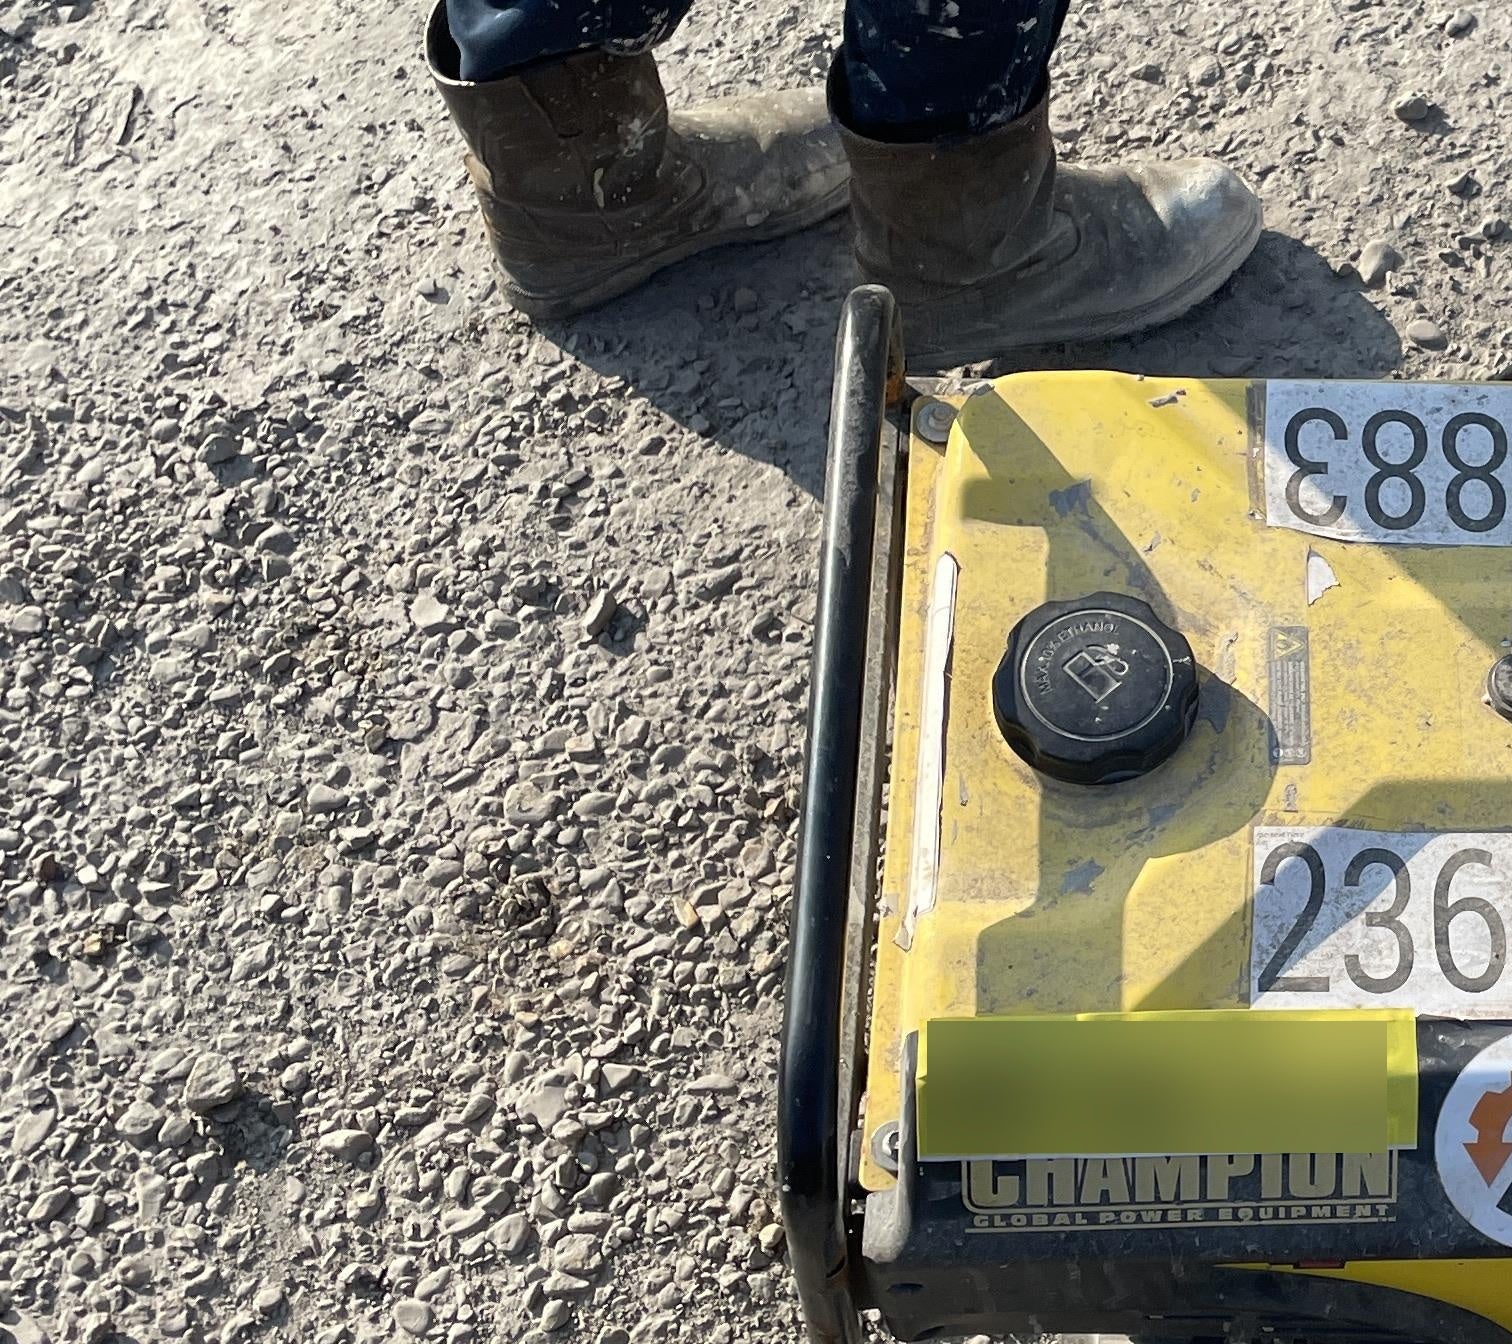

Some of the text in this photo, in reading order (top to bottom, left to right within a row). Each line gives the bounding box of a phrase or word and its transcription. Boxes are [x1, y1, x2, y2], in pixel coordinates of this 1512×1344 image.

[1058, 622, 1119, 641] ETHANOL
[970, 1153, 1387, 1207] CHAMPION
[973, 1204, 1389, 1228] GLOBAL POWER EQUIPMENT
